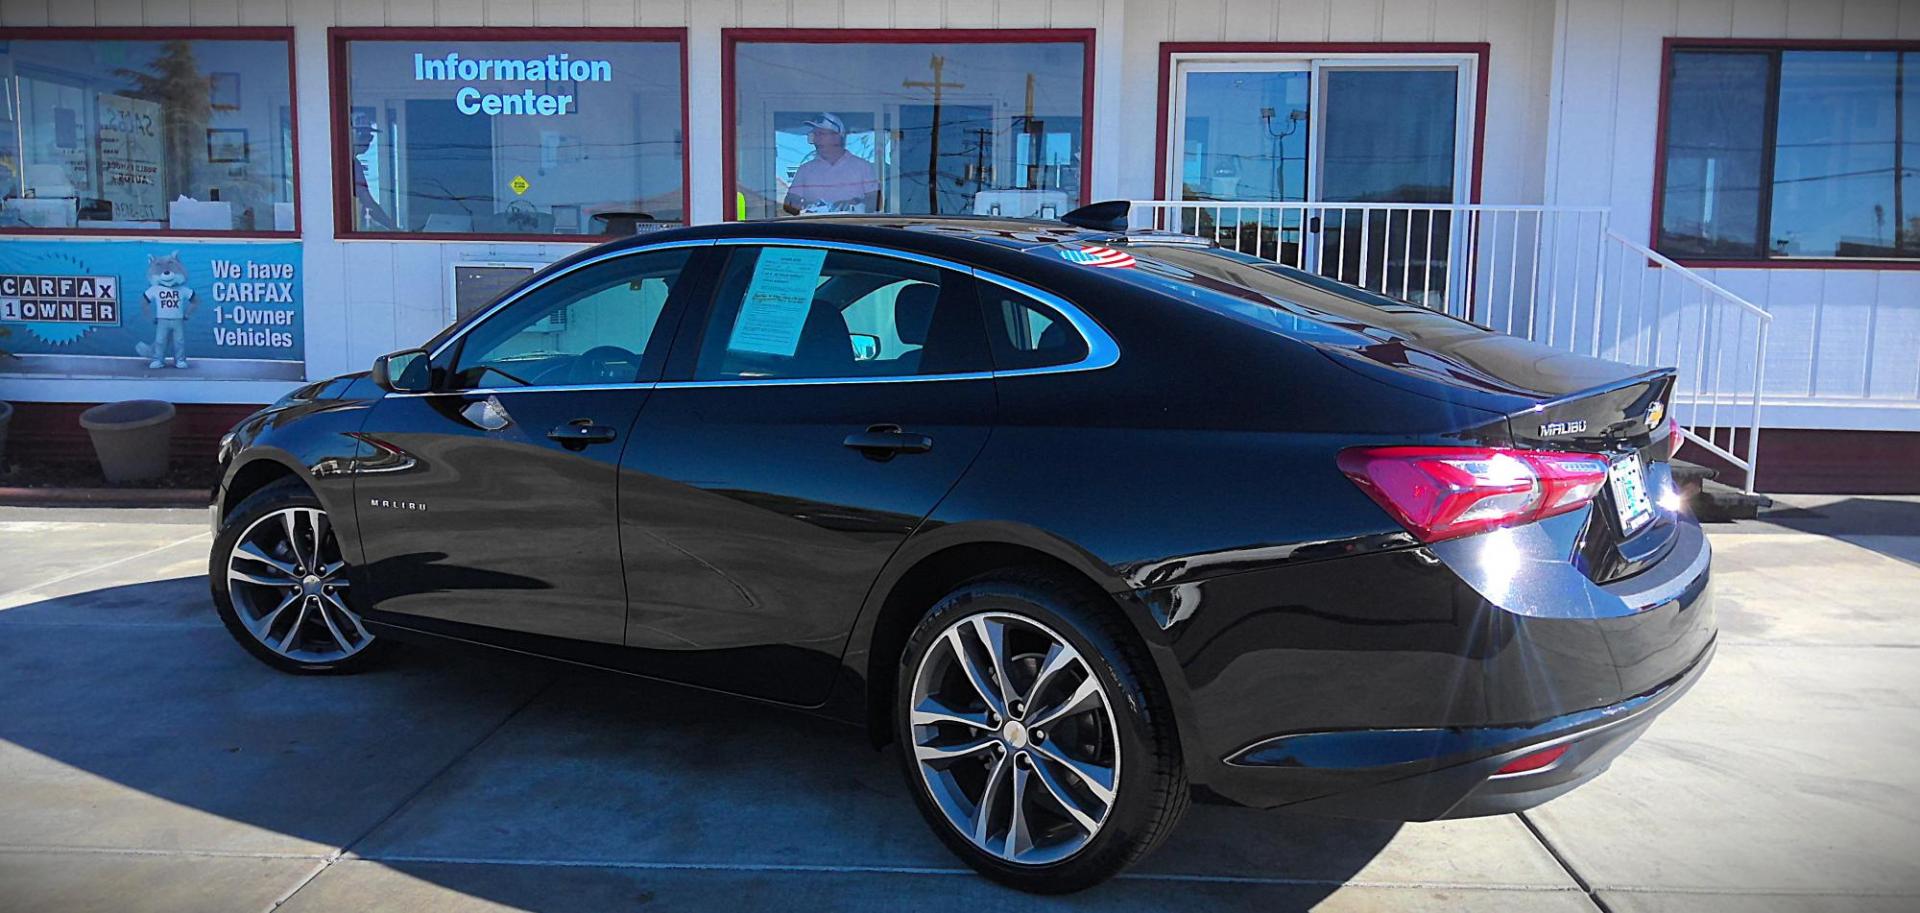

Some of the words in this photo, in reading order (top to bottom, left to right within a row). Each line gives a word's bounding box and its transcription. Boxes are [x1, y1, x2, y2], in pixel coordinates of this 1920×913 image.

[415, 53, 611, 81] Information
[456, 87, 572, 115] Center
[211, 260, 241, 279] We
[248, 260, 294, 279] have
[3, 278, 112, 299] CARFAX
[159, 291, 180, 300] CAR
[212, 282, 293, 303] CARFAX
[160, 301, 180, 309] FOX
[213, 306, 295, 325] 1-Owner
[213, 328, 293, 347] Vehicles
[1540, 420, 1587, 437] MALIBU
[370, 499, 427, 511] MALIBU
